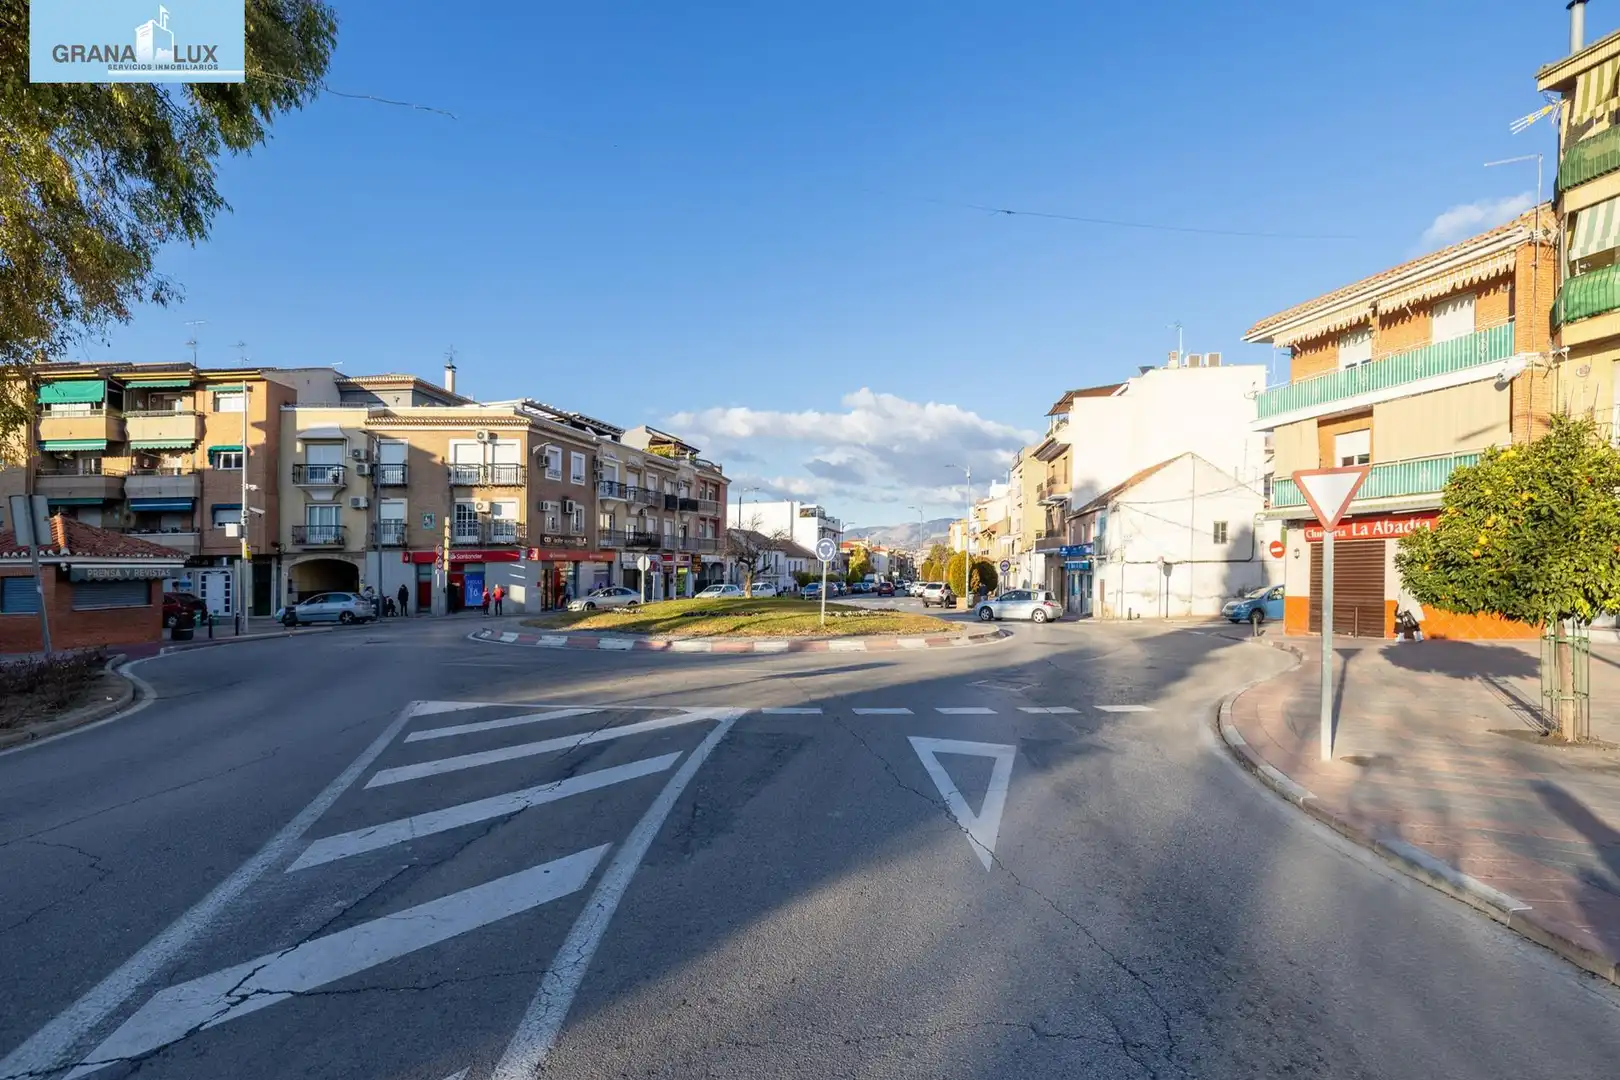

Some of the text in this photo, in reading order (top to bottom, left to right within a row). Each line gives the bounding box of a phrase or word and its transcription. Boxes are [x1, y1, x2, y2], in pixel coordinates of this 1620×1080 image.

[1351, 522, 1369, 537] La
[87, 568, 171, 578] PRENSA Y REVISTAS
